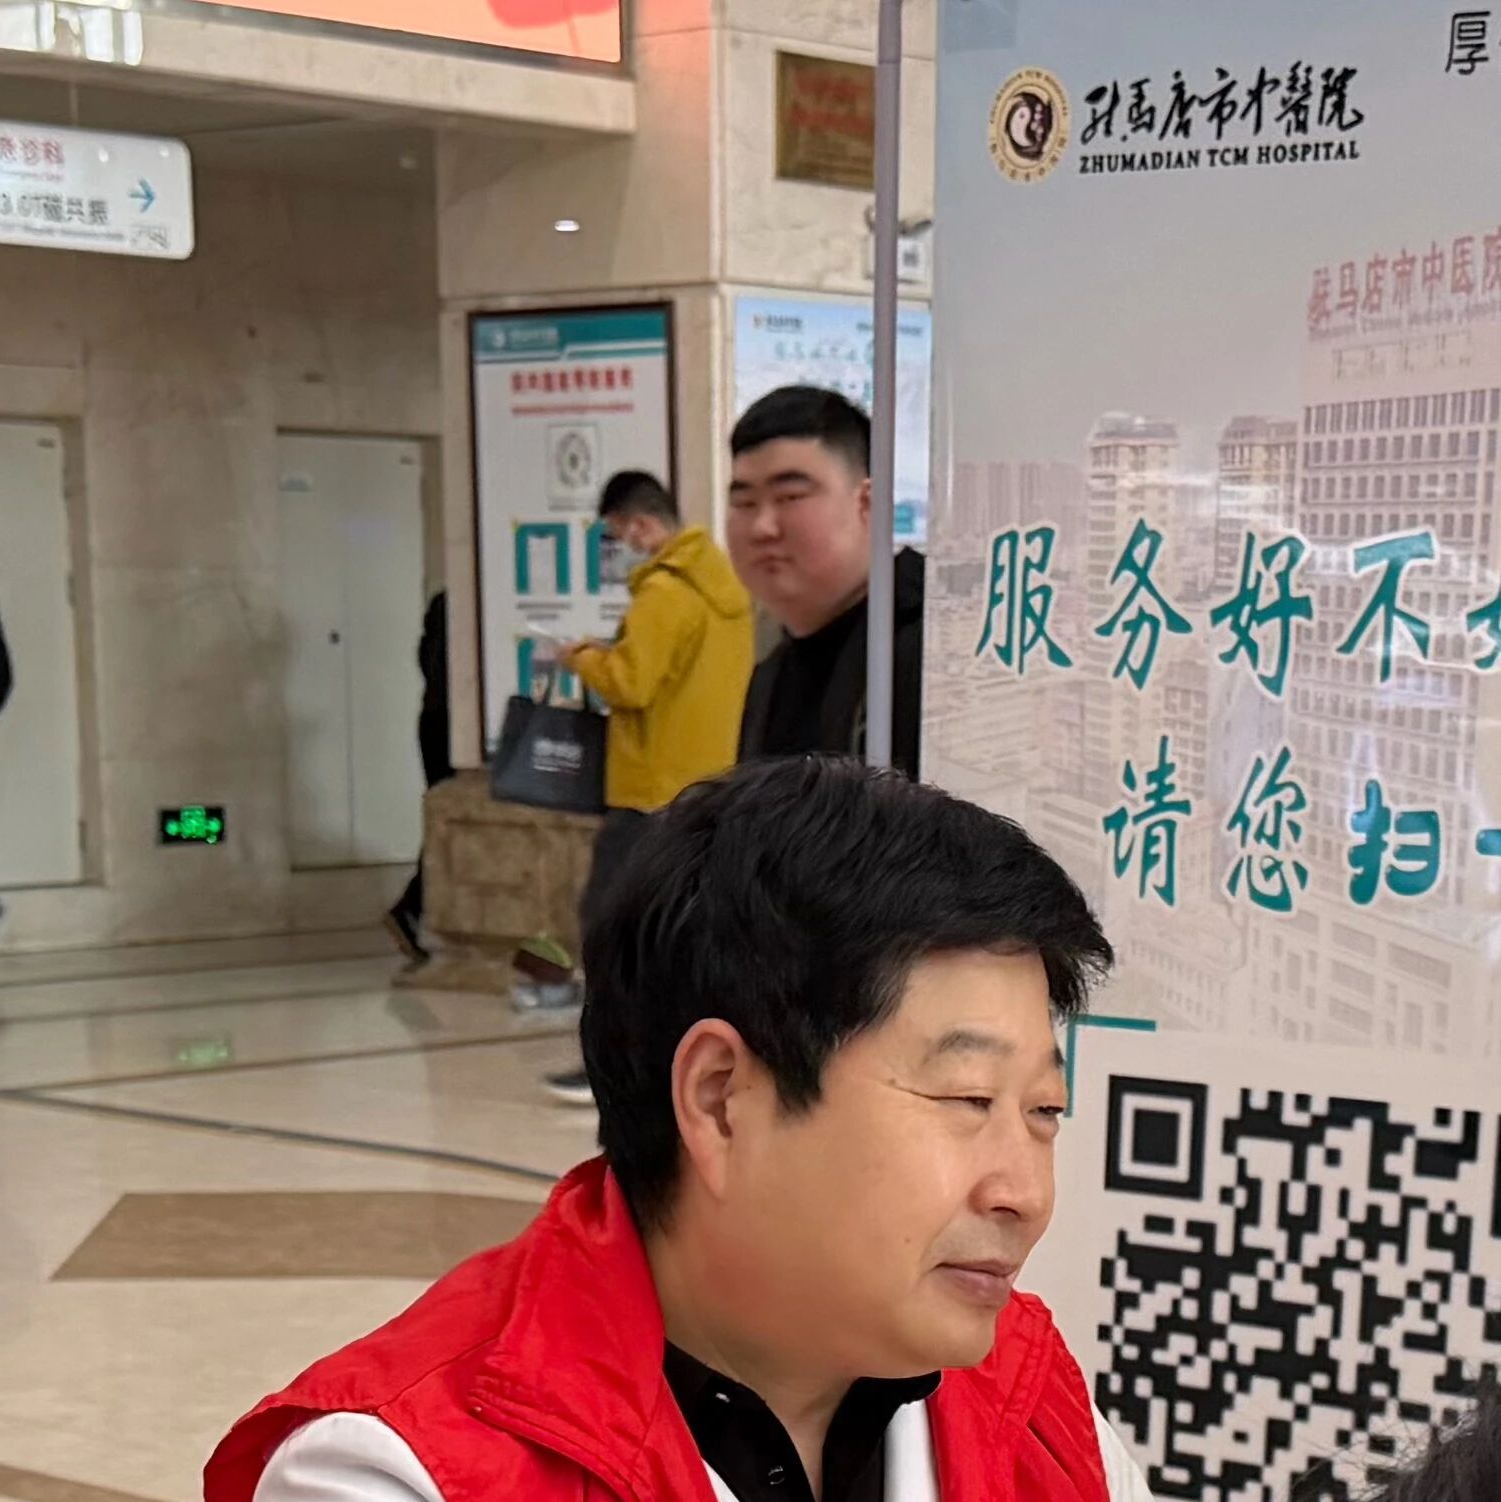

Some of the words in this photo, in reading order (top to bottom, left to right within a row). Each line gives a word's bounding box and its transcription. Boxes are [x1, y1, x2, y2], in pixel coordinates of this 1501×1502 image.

[1079, 149, 1199, 175] ZHUMADIAN
[1207, 146, 1250, 168] TCM
[1257, 140, 1361, 165] HOSPITAL
